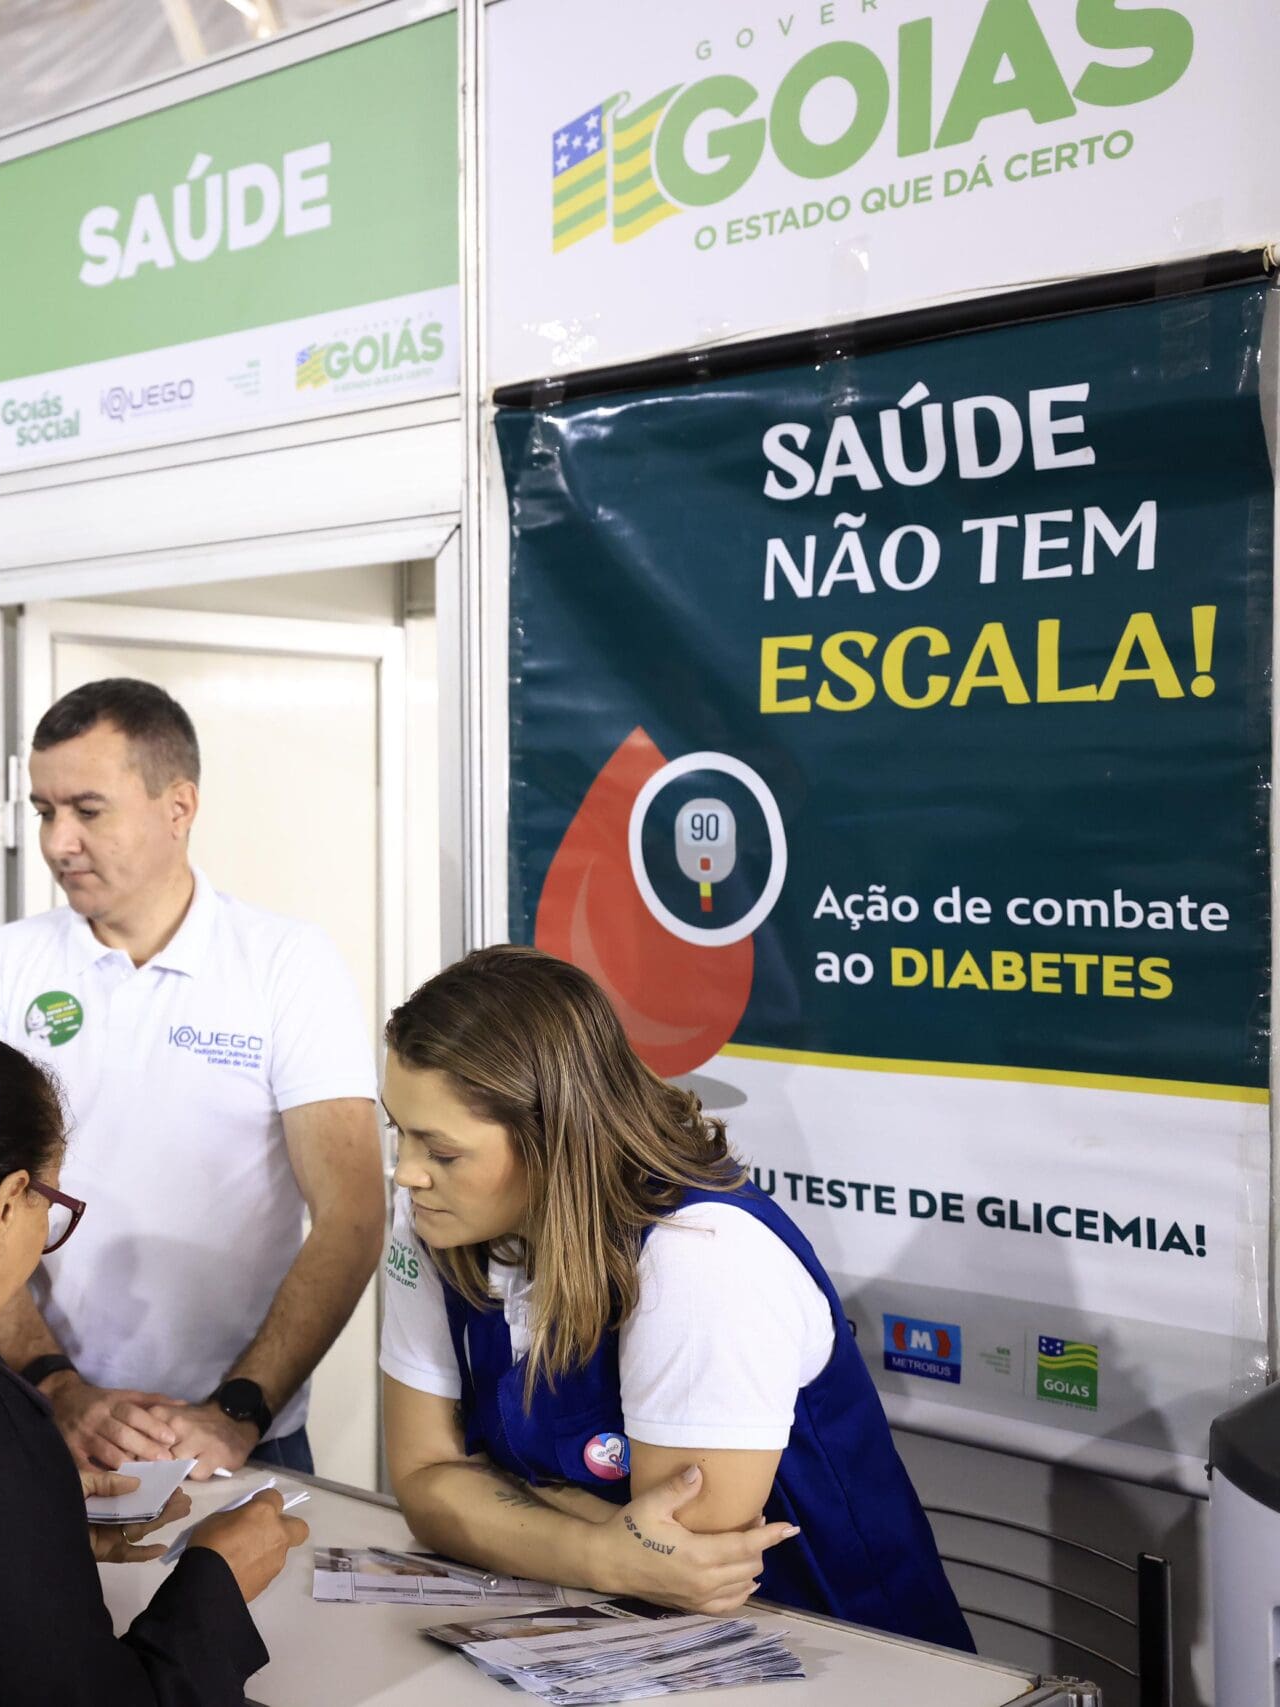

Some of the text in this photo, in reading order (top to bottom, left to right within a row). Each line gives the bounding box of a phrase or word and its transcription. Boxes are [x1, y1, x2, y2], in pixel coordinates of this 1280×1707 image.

[79, 141, 331, 286] SAÚDE
[694, 129, 1135, 251] O ESTADO QUE DÁ CERTO
[324, 318, 444, 379] GOIÁS
[16, 410, 80, 446] social
[762, 382, 1095, 500] SAÚDE
[764, 501, 1157, 600] NÃO TEM
[760, 605, 1217, 713] ESCALA!
[690, 813, 720, 842] 90
[814, 885, 1230, 932] Ação de combate
[814, 947, 1173, 999] ao DIABETES
[784, 1172, 896, 1215] TESTE
[909, 1189, 964, 1224] DE
[976, 1196, 1207, 1258] GLICEMIA!
[891, 1356, 951, 1377] METROBUS
[910, 1330, 932, 1350] M
